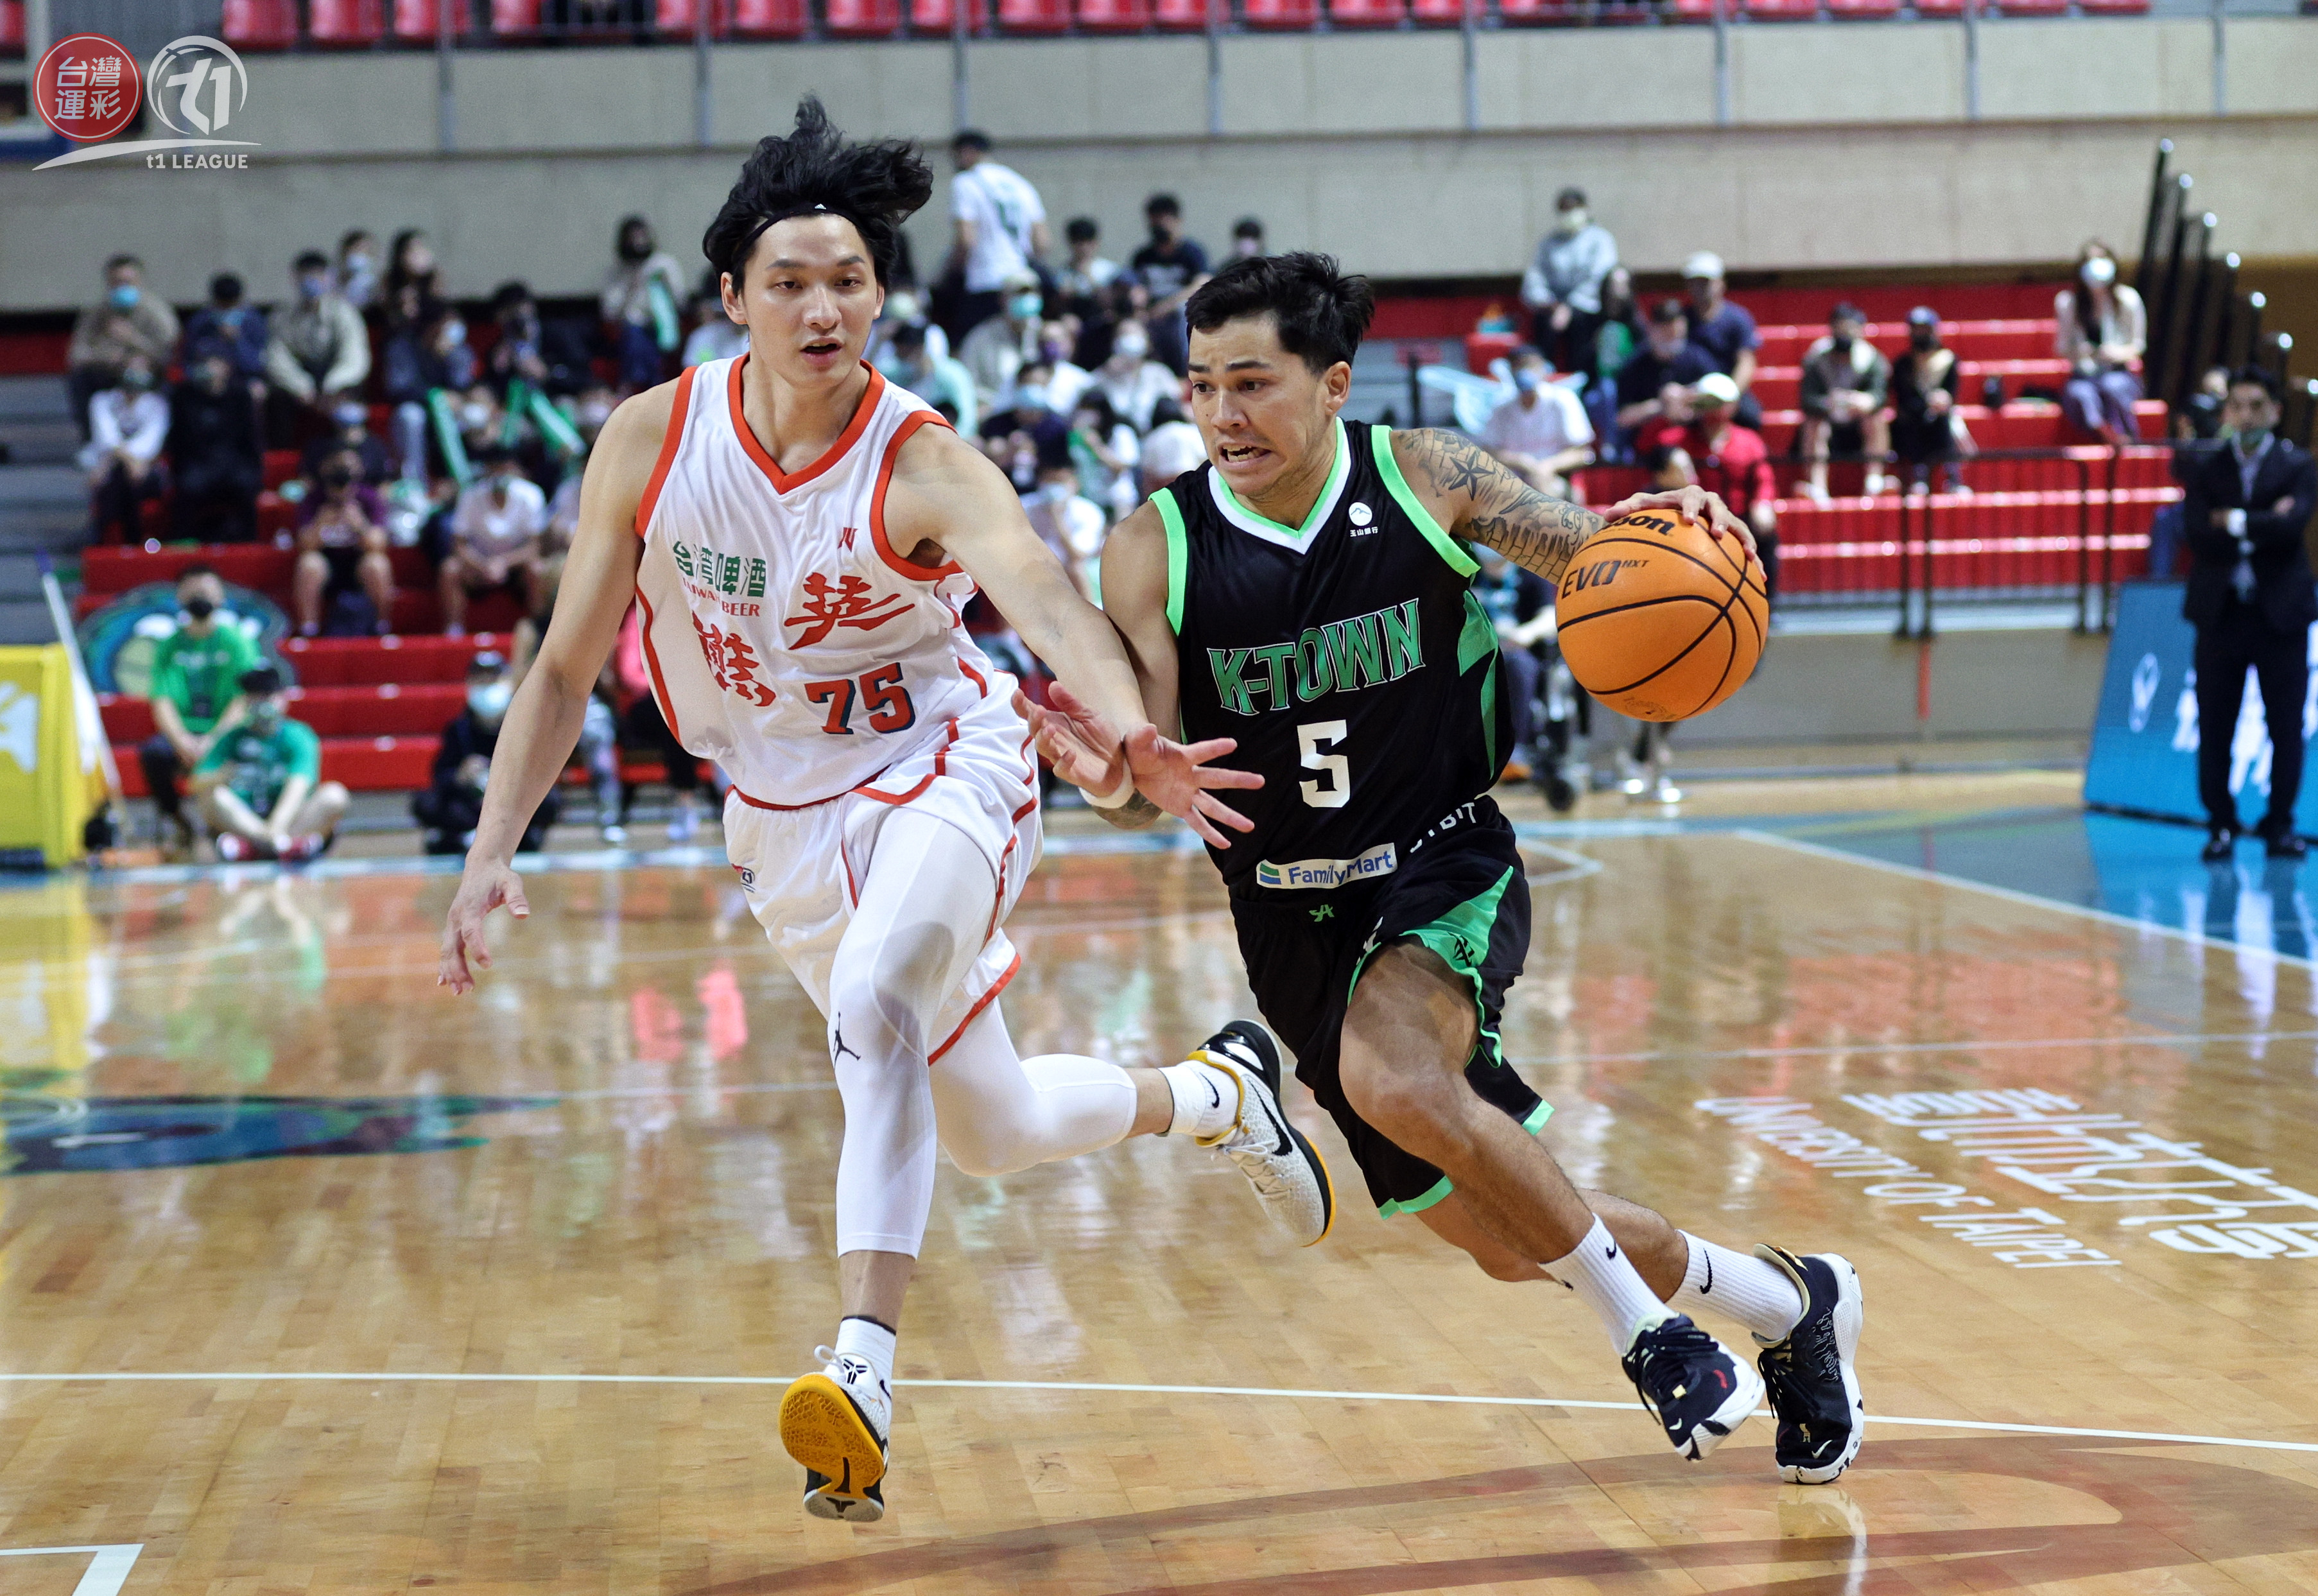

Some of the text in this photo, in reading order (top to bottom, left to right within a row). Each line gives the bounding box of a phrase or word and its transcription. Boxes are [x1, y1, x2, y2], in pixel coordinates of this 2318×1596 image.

[1561, 560, 1622, 600] EVO
[722, 601, 760, 617] BEER
[1207, 597, 1426, 716] K-TOWN
[804, 663, 916, 735] 75
[1297, 719, 1351, 808] 5
[1288, 851, 1393, 885] FamilyMart
[1863, 1181, 1995, 1207] OF
[1918, 1207, 2122, 1269] TAIPEI
